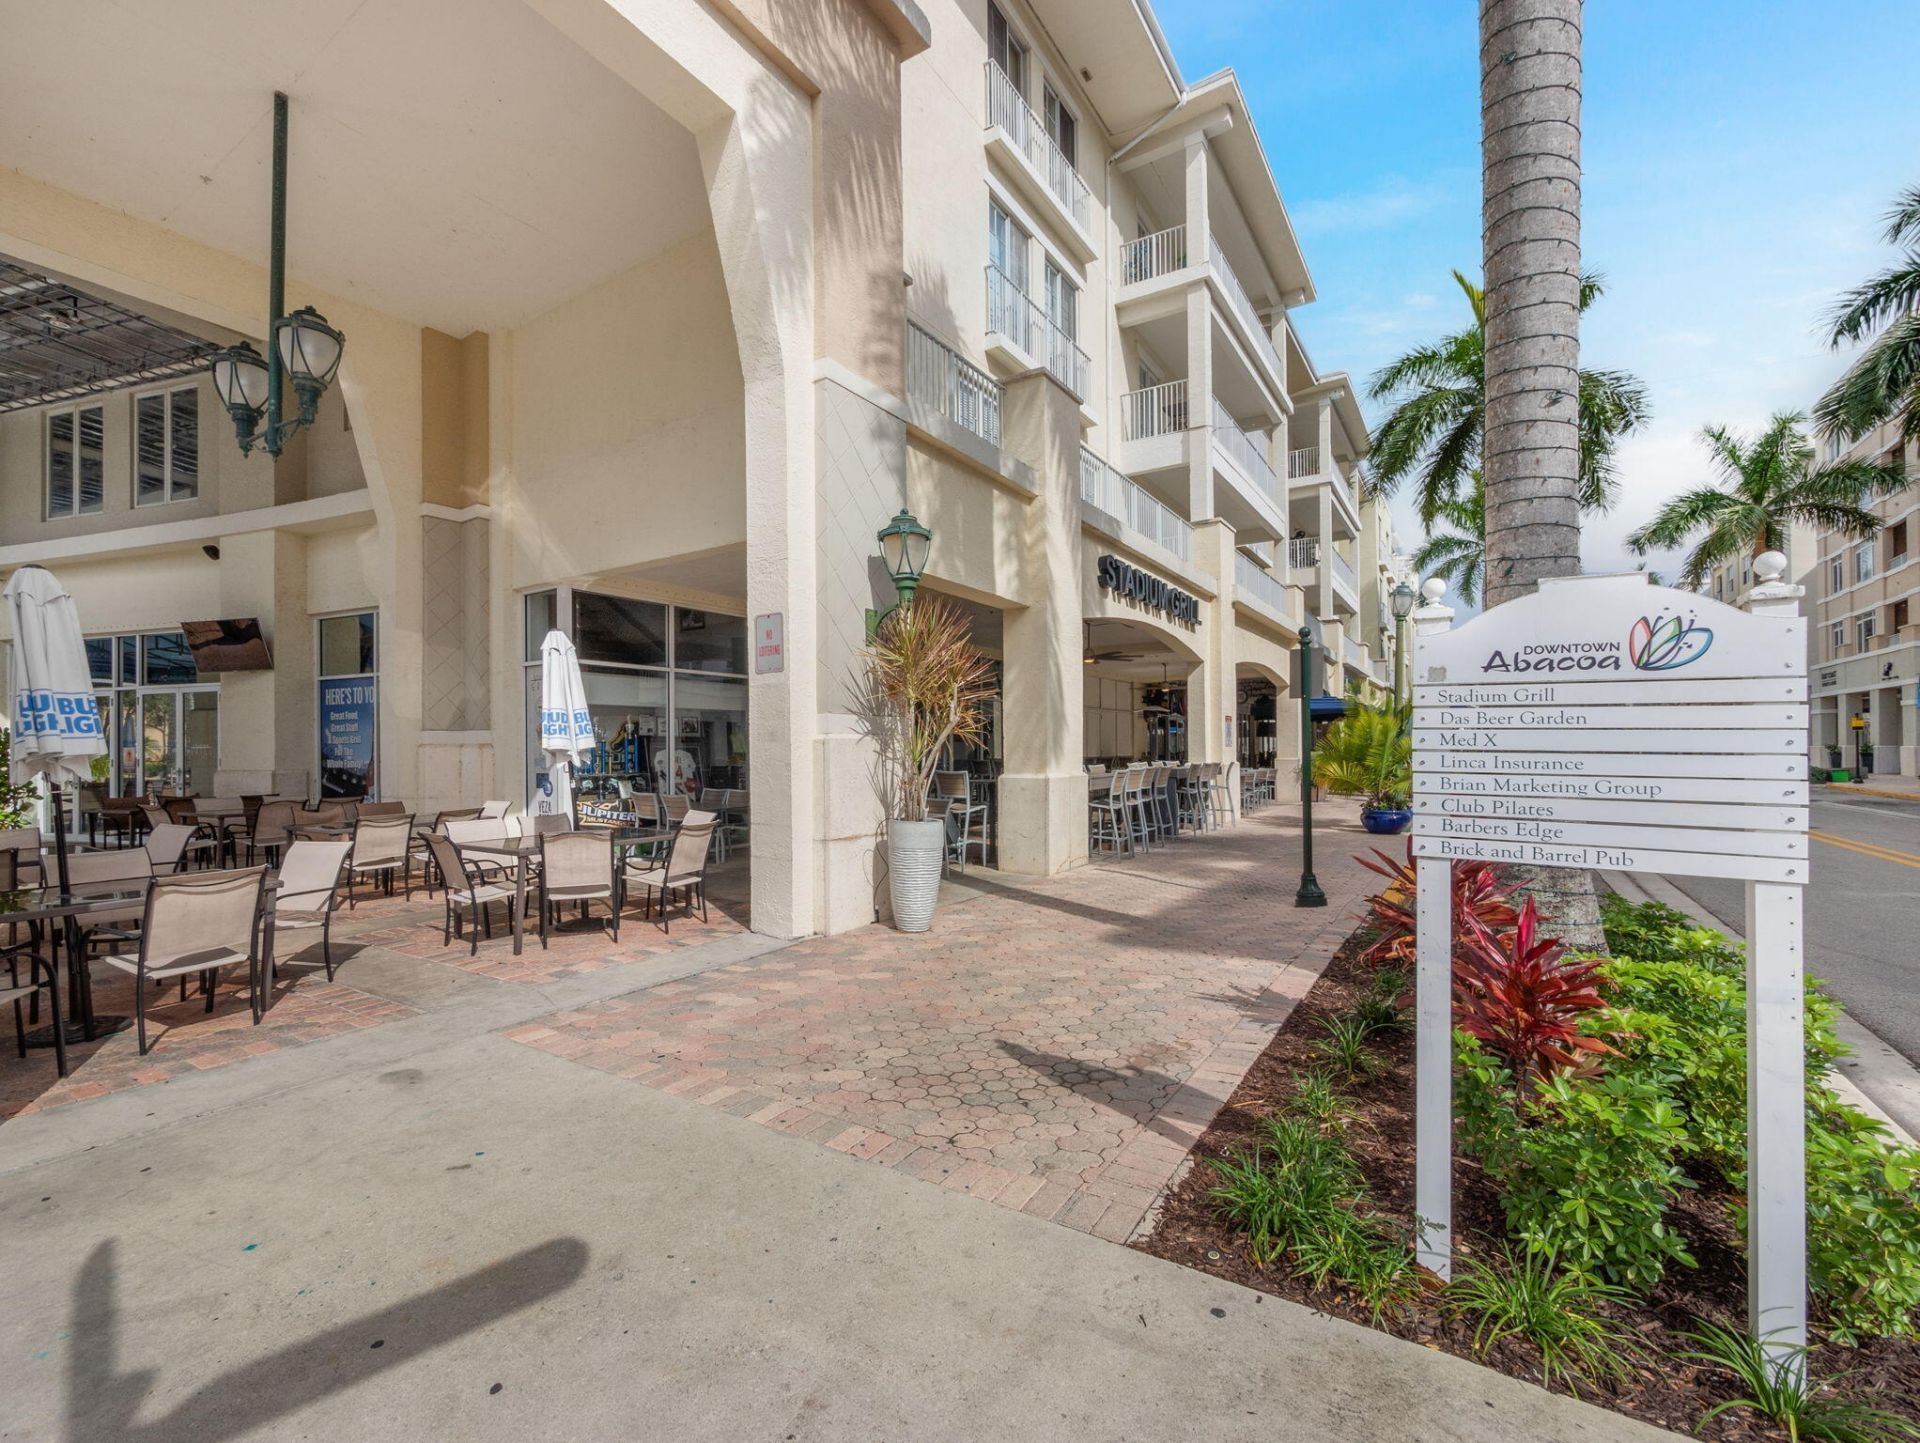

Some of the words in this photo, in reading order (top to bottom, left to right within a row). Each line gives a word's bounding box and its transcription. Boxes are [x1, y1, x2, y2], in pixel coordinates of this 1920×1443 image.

[1098, 554, 1169, 611] STADIUM
[1167, 587, 1202, 626] GRILL
[765, 629, 773, 640] NO
[1523, 641, 1621, 655] DOWNTOWN
[1480, 650, 1621, 673] Abacoa
[325, 687, 352, 705] HERE'S
[353, 687, 363, 704] TO
[1437, 688, 1507, 703] Stadium
[1513, 687, 1555, 702] Grill
[1440, 711, 1470, 725] Das
[1476, 711, 1514, 726] Beer
[1519, 711, 1588, 726] Garden
[1439, 732, 1479, 747] Med
[1483, 733, 1498, 746] X
[1440, 754, 1487, 769] Linca
[1494, 755, 1585, 770] Insurance
[1440, 776, 1487, 791] Brian
[1493, 777, 1589, 796] Marketing
[1594, 779, 1663, 798] Group
[580, 805, 637, 821] JUPITER
[1441, 798, 1485, 814] Club
[1492, 800, 1554, 816] Pilates
[1441, 818, 1509, 835] Barbers
[1515, 822, 1563, 840] Edge
[1440, 840, 1485, 857] Brick
[1490, 844, 1524, 860] and
[1532, 846, 1588, 863] Barrel
[1596, 849, 1634, 867] Pub
